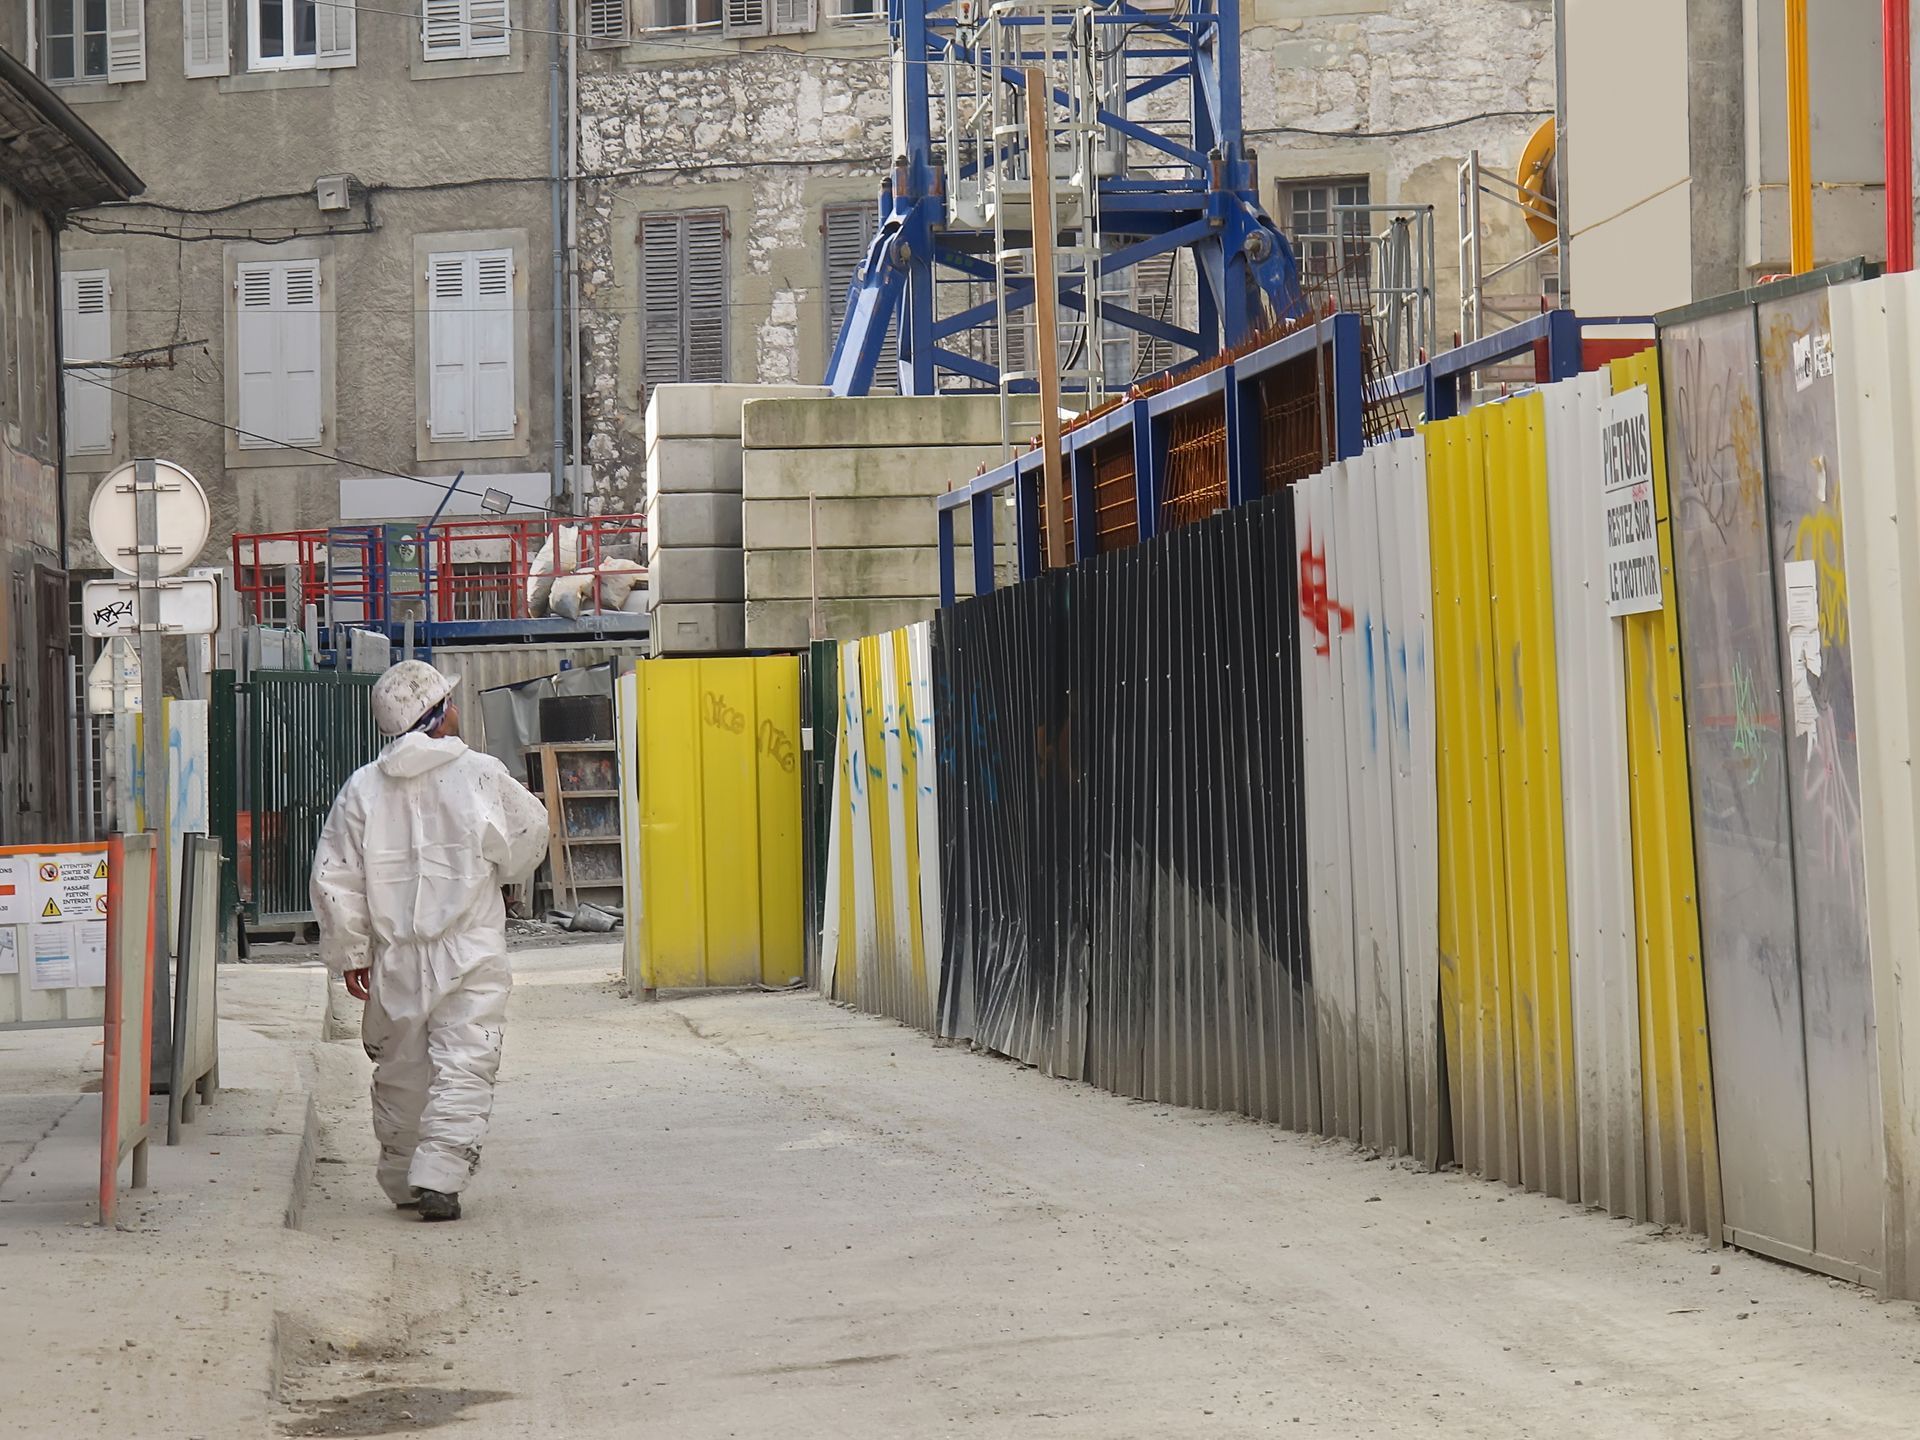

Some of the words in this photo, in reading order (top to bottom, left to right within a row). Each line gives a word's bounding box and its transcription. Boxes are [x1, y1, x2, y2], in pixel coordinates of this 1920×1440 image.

[1607, 503, 1635, 547] RESTEZ
[1634, 499, 1652, 542] SUR
[1609, 562, 1620, 602] LE
[1619, 555, 1658, 600] TROTTOIR
